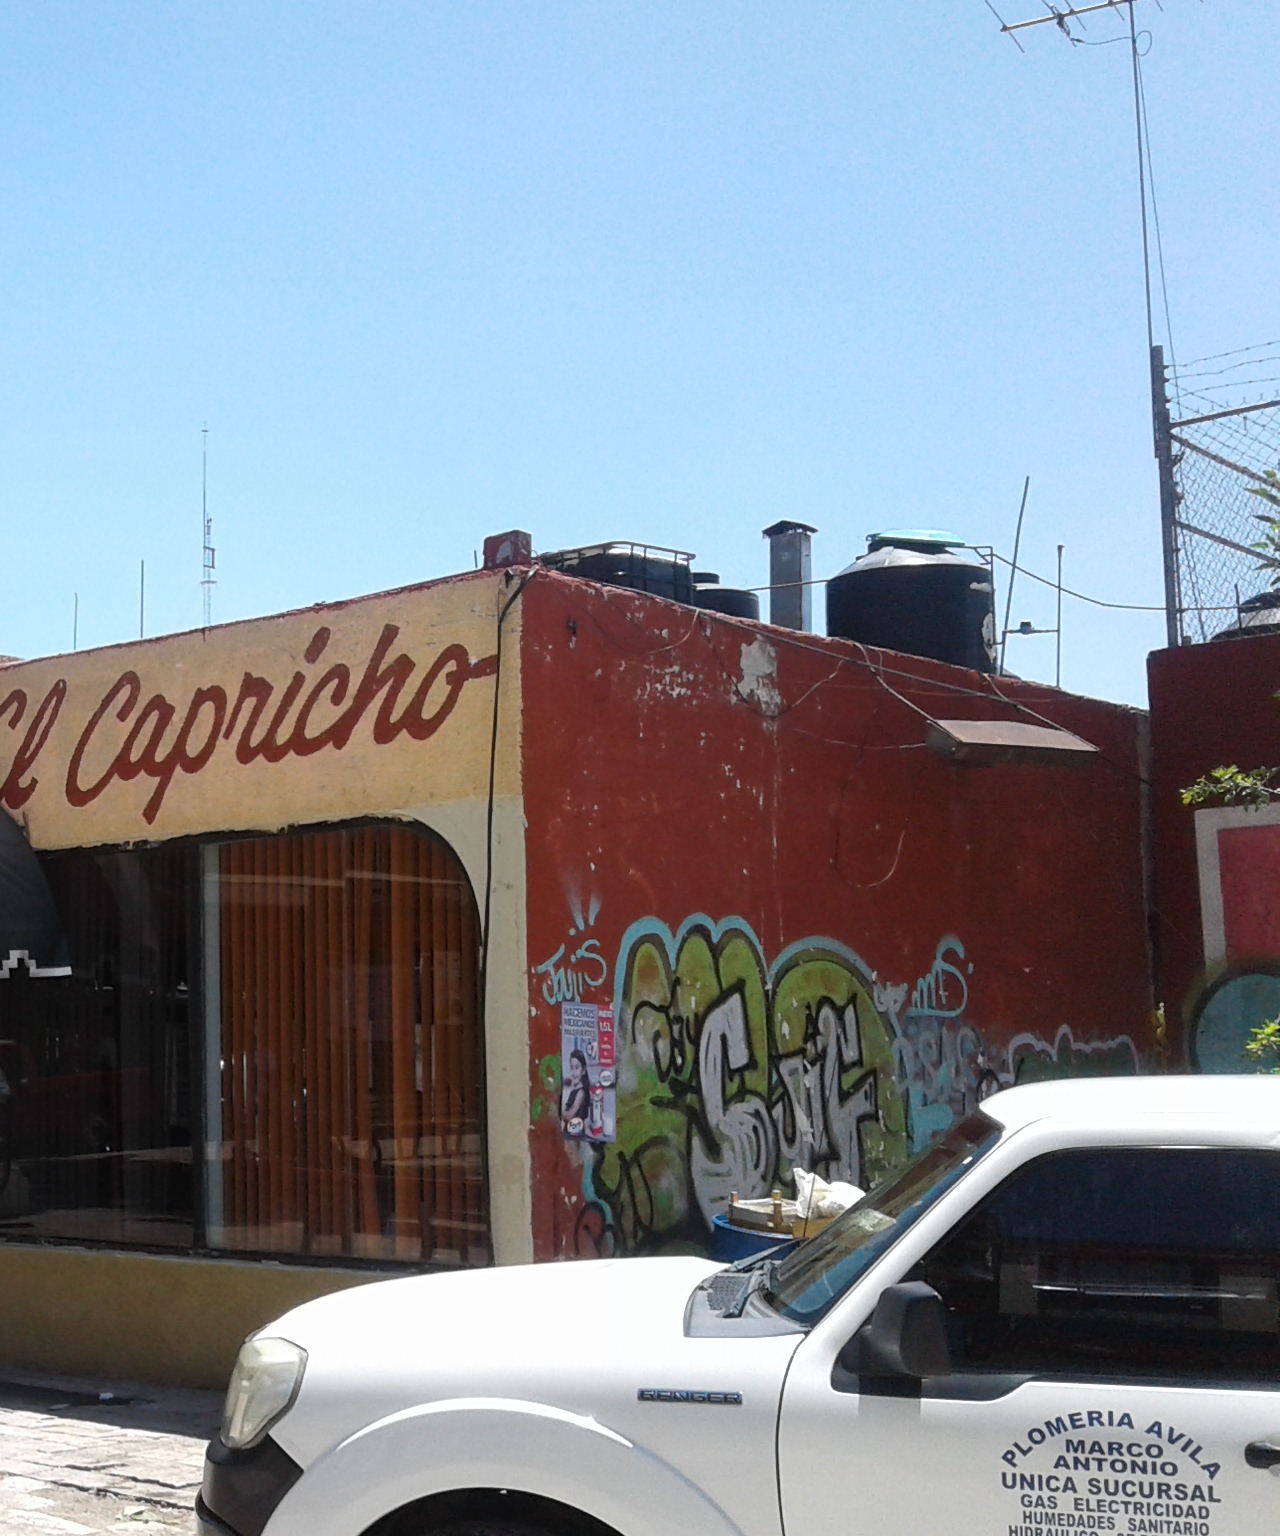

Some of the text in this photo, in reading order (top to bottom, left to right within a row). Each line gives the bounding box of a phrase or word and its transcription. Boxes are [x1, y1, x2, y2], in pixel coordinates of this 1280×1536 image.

[65, 623, 498, 825] Capricho
[563, 1006, 596, 1018] HACEMOS
[1001, 1410, 1222, 1480] PLOMERIA AVILA
[1065, 1439, 1164, 1459] MARCO
[1053, 1455, 1179, 1477] ANTONIO
[1001, 1472, 1222, 1503] UNICA SUCURSAL
[1020, 1494, 1210, 1520] GAS ELECTRICIDAD
[1022, 1510, 1210, 1536] HUMEDADES SANITARIO
